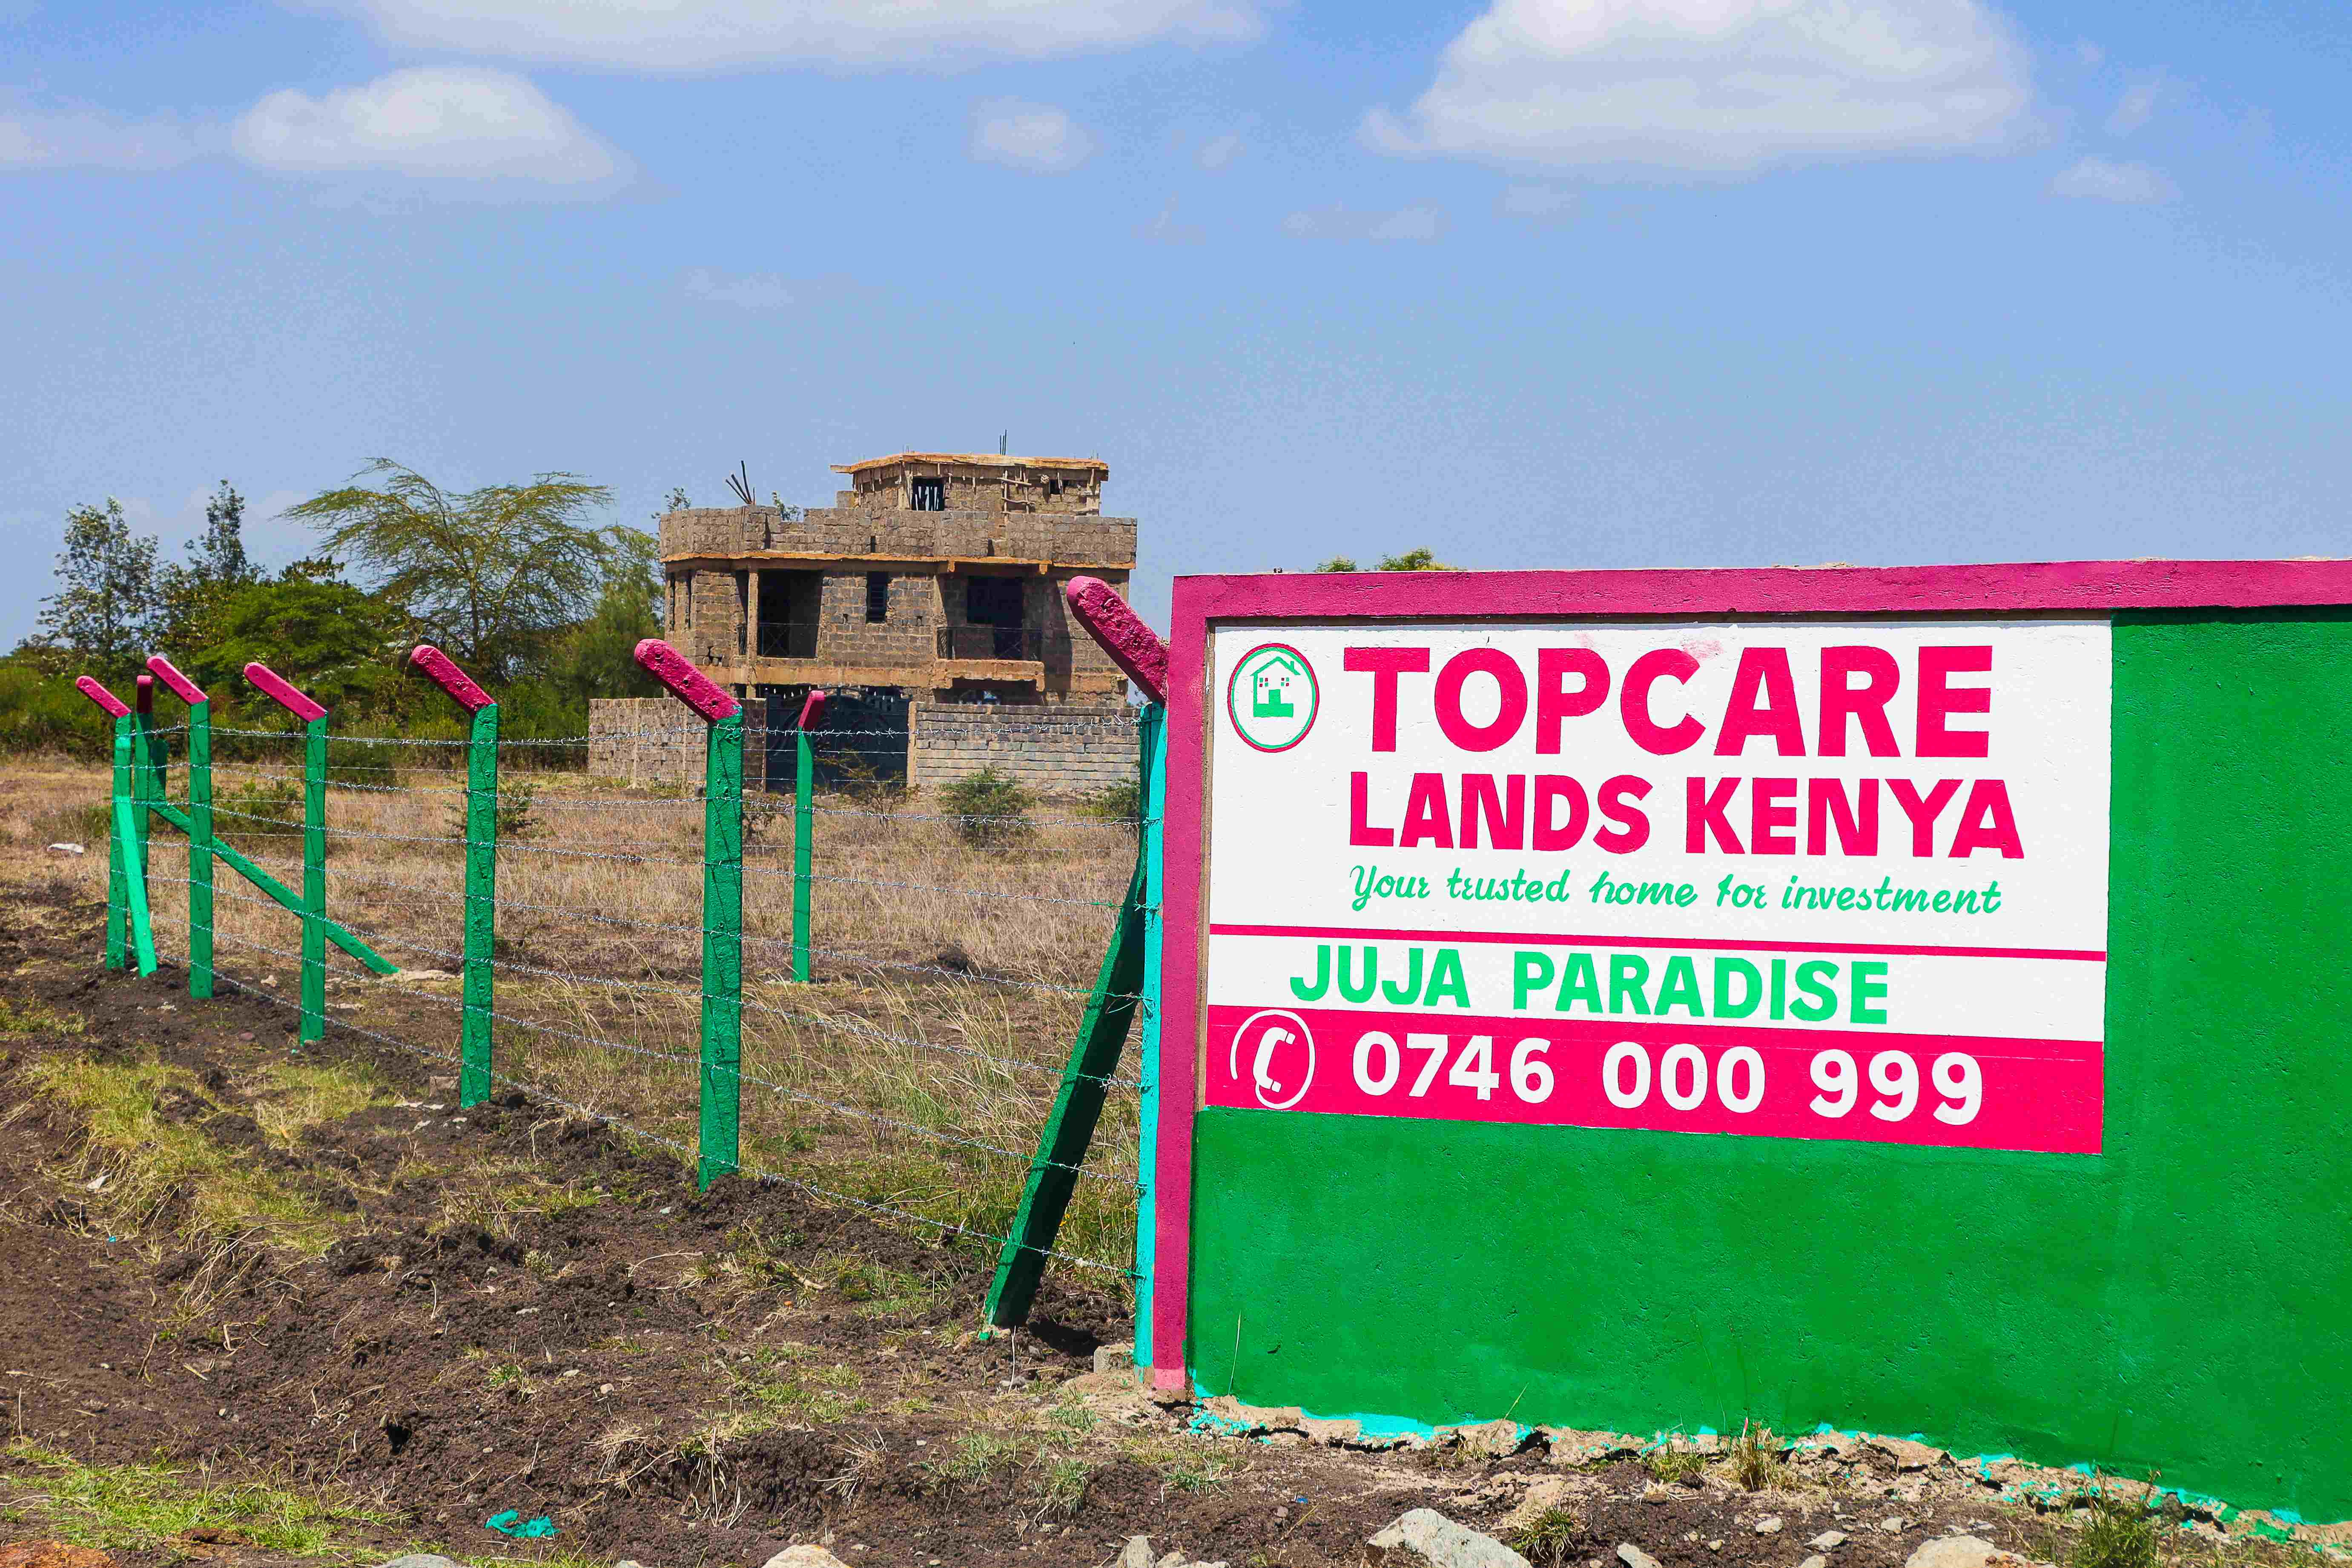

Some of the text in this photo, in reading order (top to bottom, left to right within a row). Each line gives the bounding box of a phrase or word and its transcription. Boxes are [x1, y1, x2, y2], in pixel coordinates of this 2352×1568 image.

[1343, 645, 1993, 758] TOPCARE
[1350, 771, 2024, 859] LANDS KENYA
[1350, 865, 2002, 914] Your trusted home for investment
[1289, 944, 1889, 1025] JUJA PARADISE
[1352, 1031, 1983, 1126] 0746 000 999
